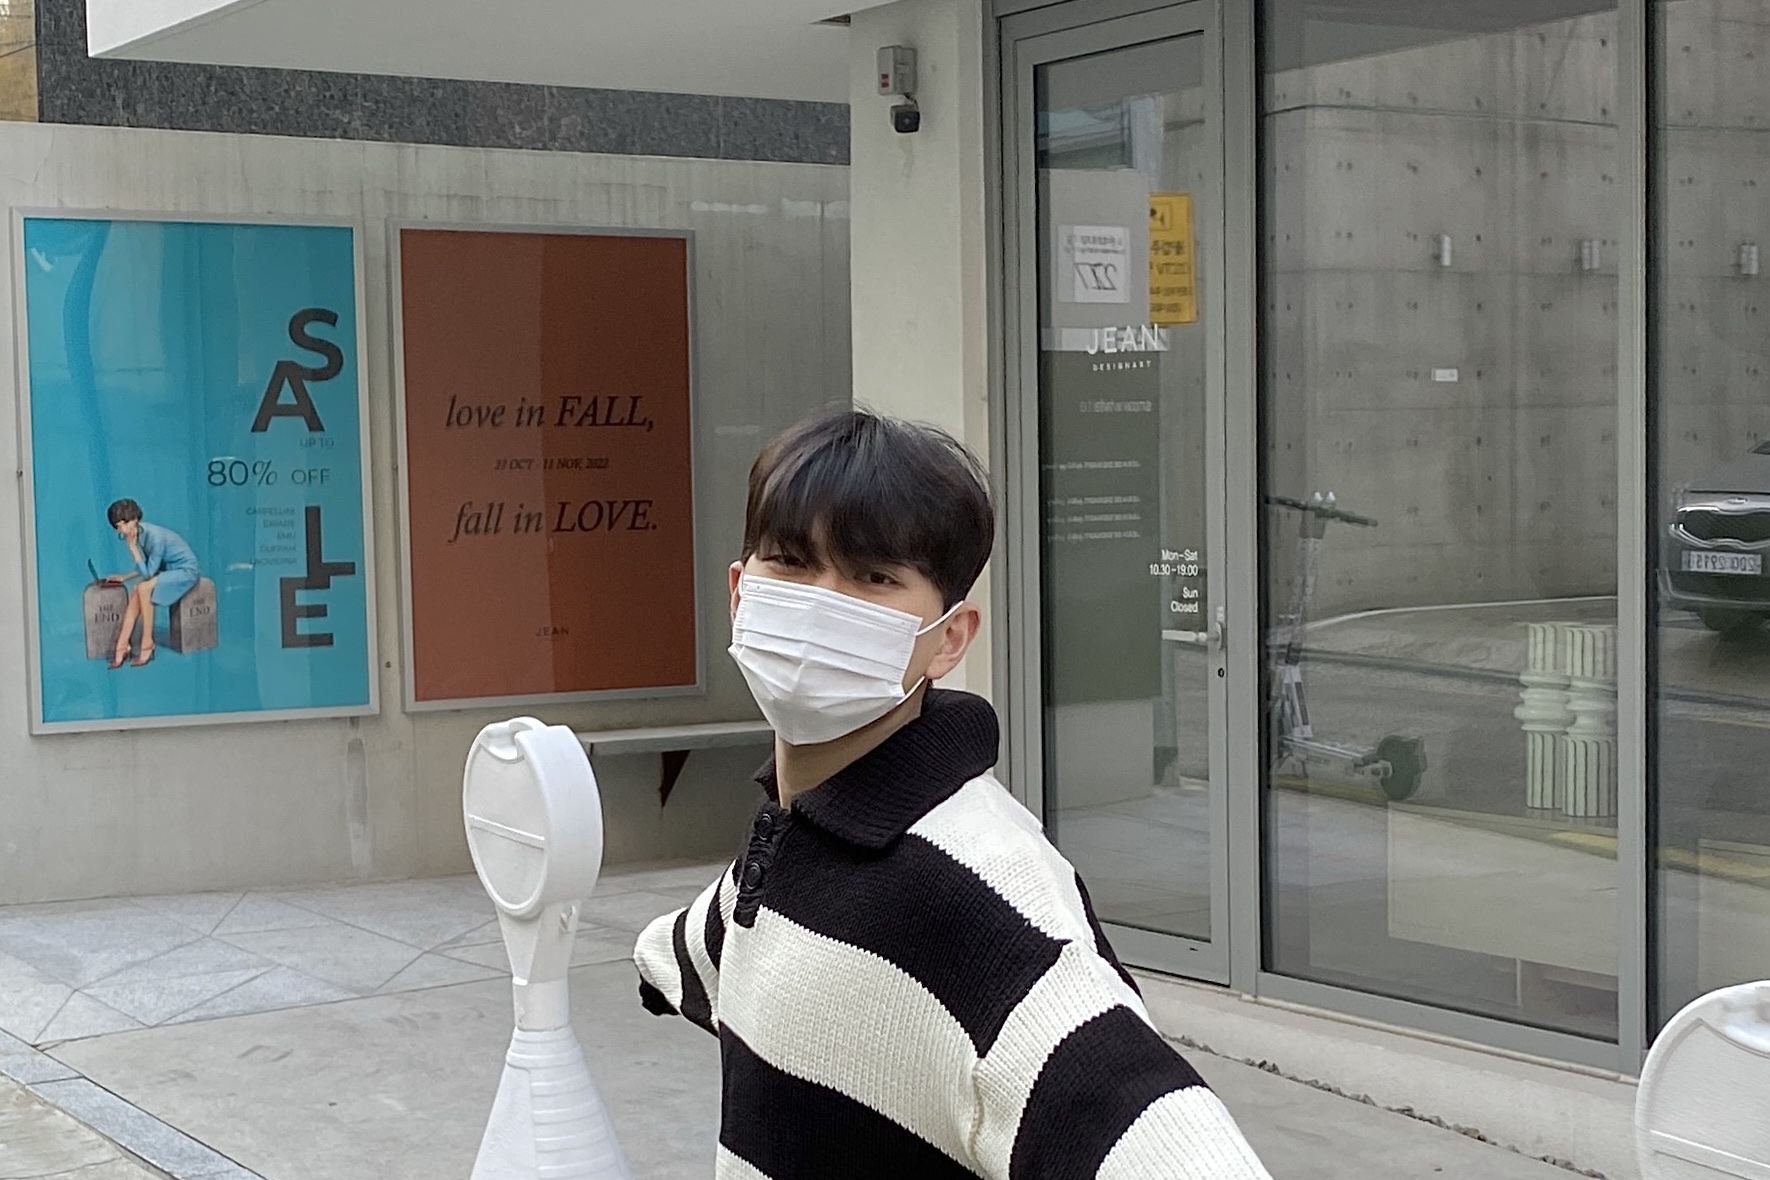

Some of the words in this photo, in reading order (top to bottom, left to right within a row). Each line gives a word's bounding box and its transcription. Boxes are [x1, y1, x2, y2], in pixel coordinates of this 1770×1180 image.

[1087, 323, 1158, 355] JEAN
[446, 394, 506, 428] love
[515, 397, 545, 428] in
[554, 395, 654, 432] FALL,
[207, 459, 278, 487] 80%
[291, 467, 331, 486] OFF
[447, 500, 505, 543] fall
[513, 503, 543, 534] in
[552, 500, 657, 532] LOVE.
[1161, 549, 1198, 561] Mon-Sat
[1182, 586, 1198, 599] Sun
[189, 606, 211, 618] END
[1170, 600, 1198, 613] Closed
[94, 612, 120, 623] END
